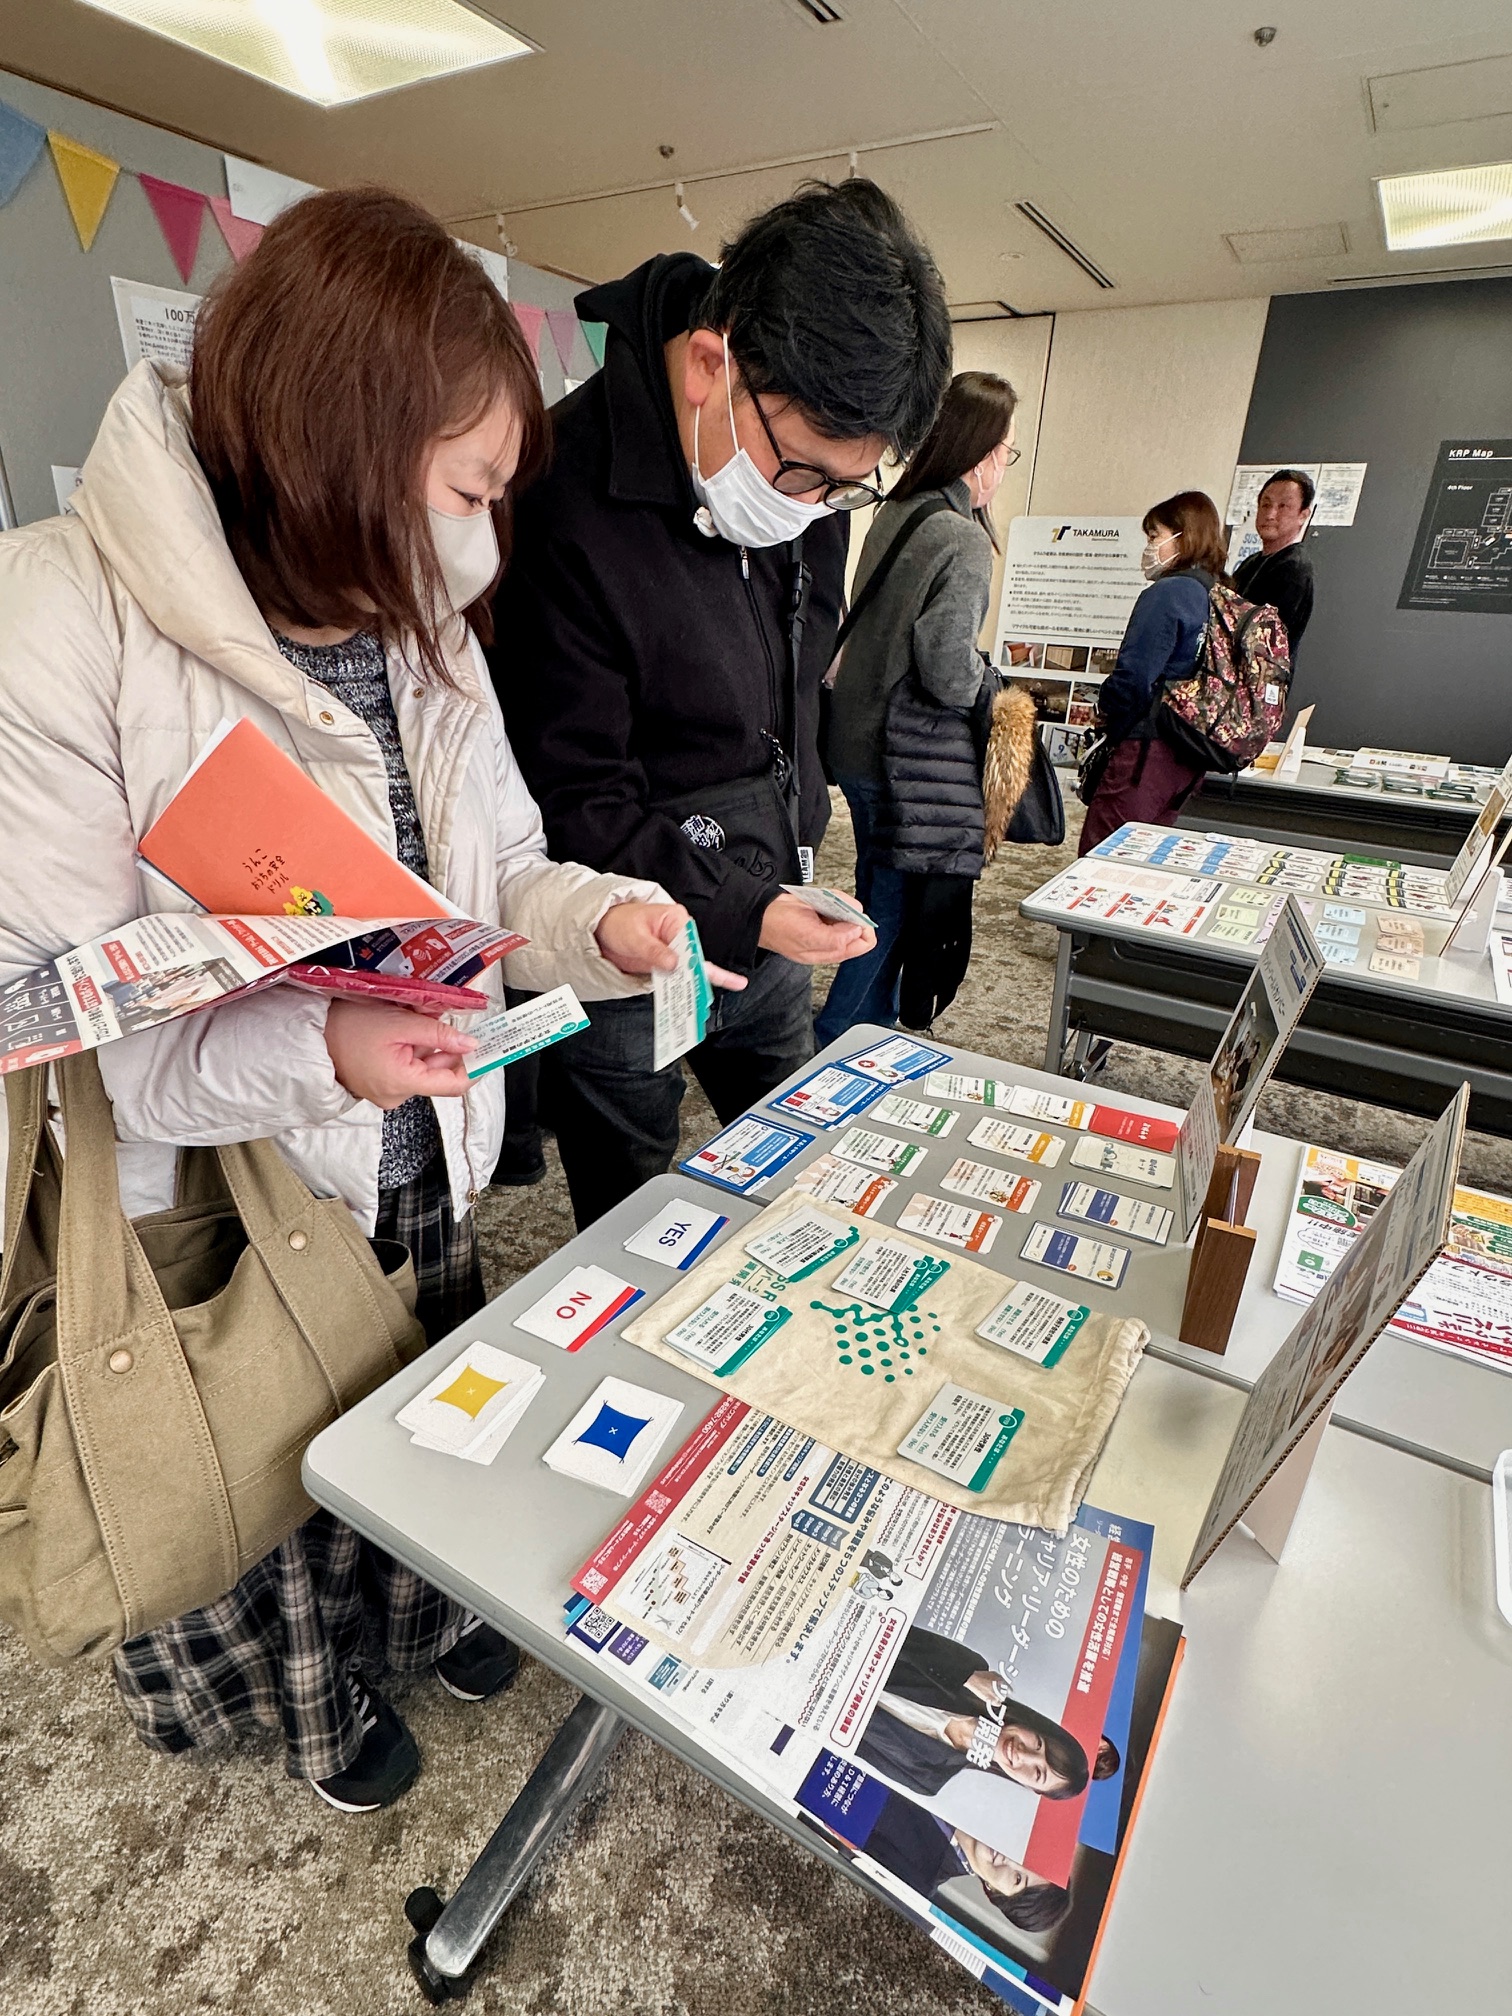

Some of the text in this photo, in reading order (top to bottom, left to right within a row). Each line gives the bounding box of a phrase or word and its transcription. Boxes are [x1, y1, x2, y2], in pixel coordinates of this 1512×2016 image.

[1473, 449, 1493, 458] Map
[1073, 529, 1119, 537] TAKAMURA
[242, 848, 267, 874] うんこ
[267, 873, 289, 893] ドリル
[657, 1222, 691, 1250] YES
[556, 1290, 592, 1322] NO
[906, 1410, 937, 1449] 受け入れない (No)
[928, 1415, 948, 1439] 受け入れる
[916, 1441, 930, 1455] (Yes)
[972, 1431, 991, 1454] 30代男性
[989, 1524, 1036, 1609] ラーニング
[1042, 1532, 1093, 1640] 女性のための
[1075, 1552, 1123, 1693] 経営戦略としての女性活躍を推進
[838, 1617, 897, 1734] 女性自身が持つキャリア開発の課題
